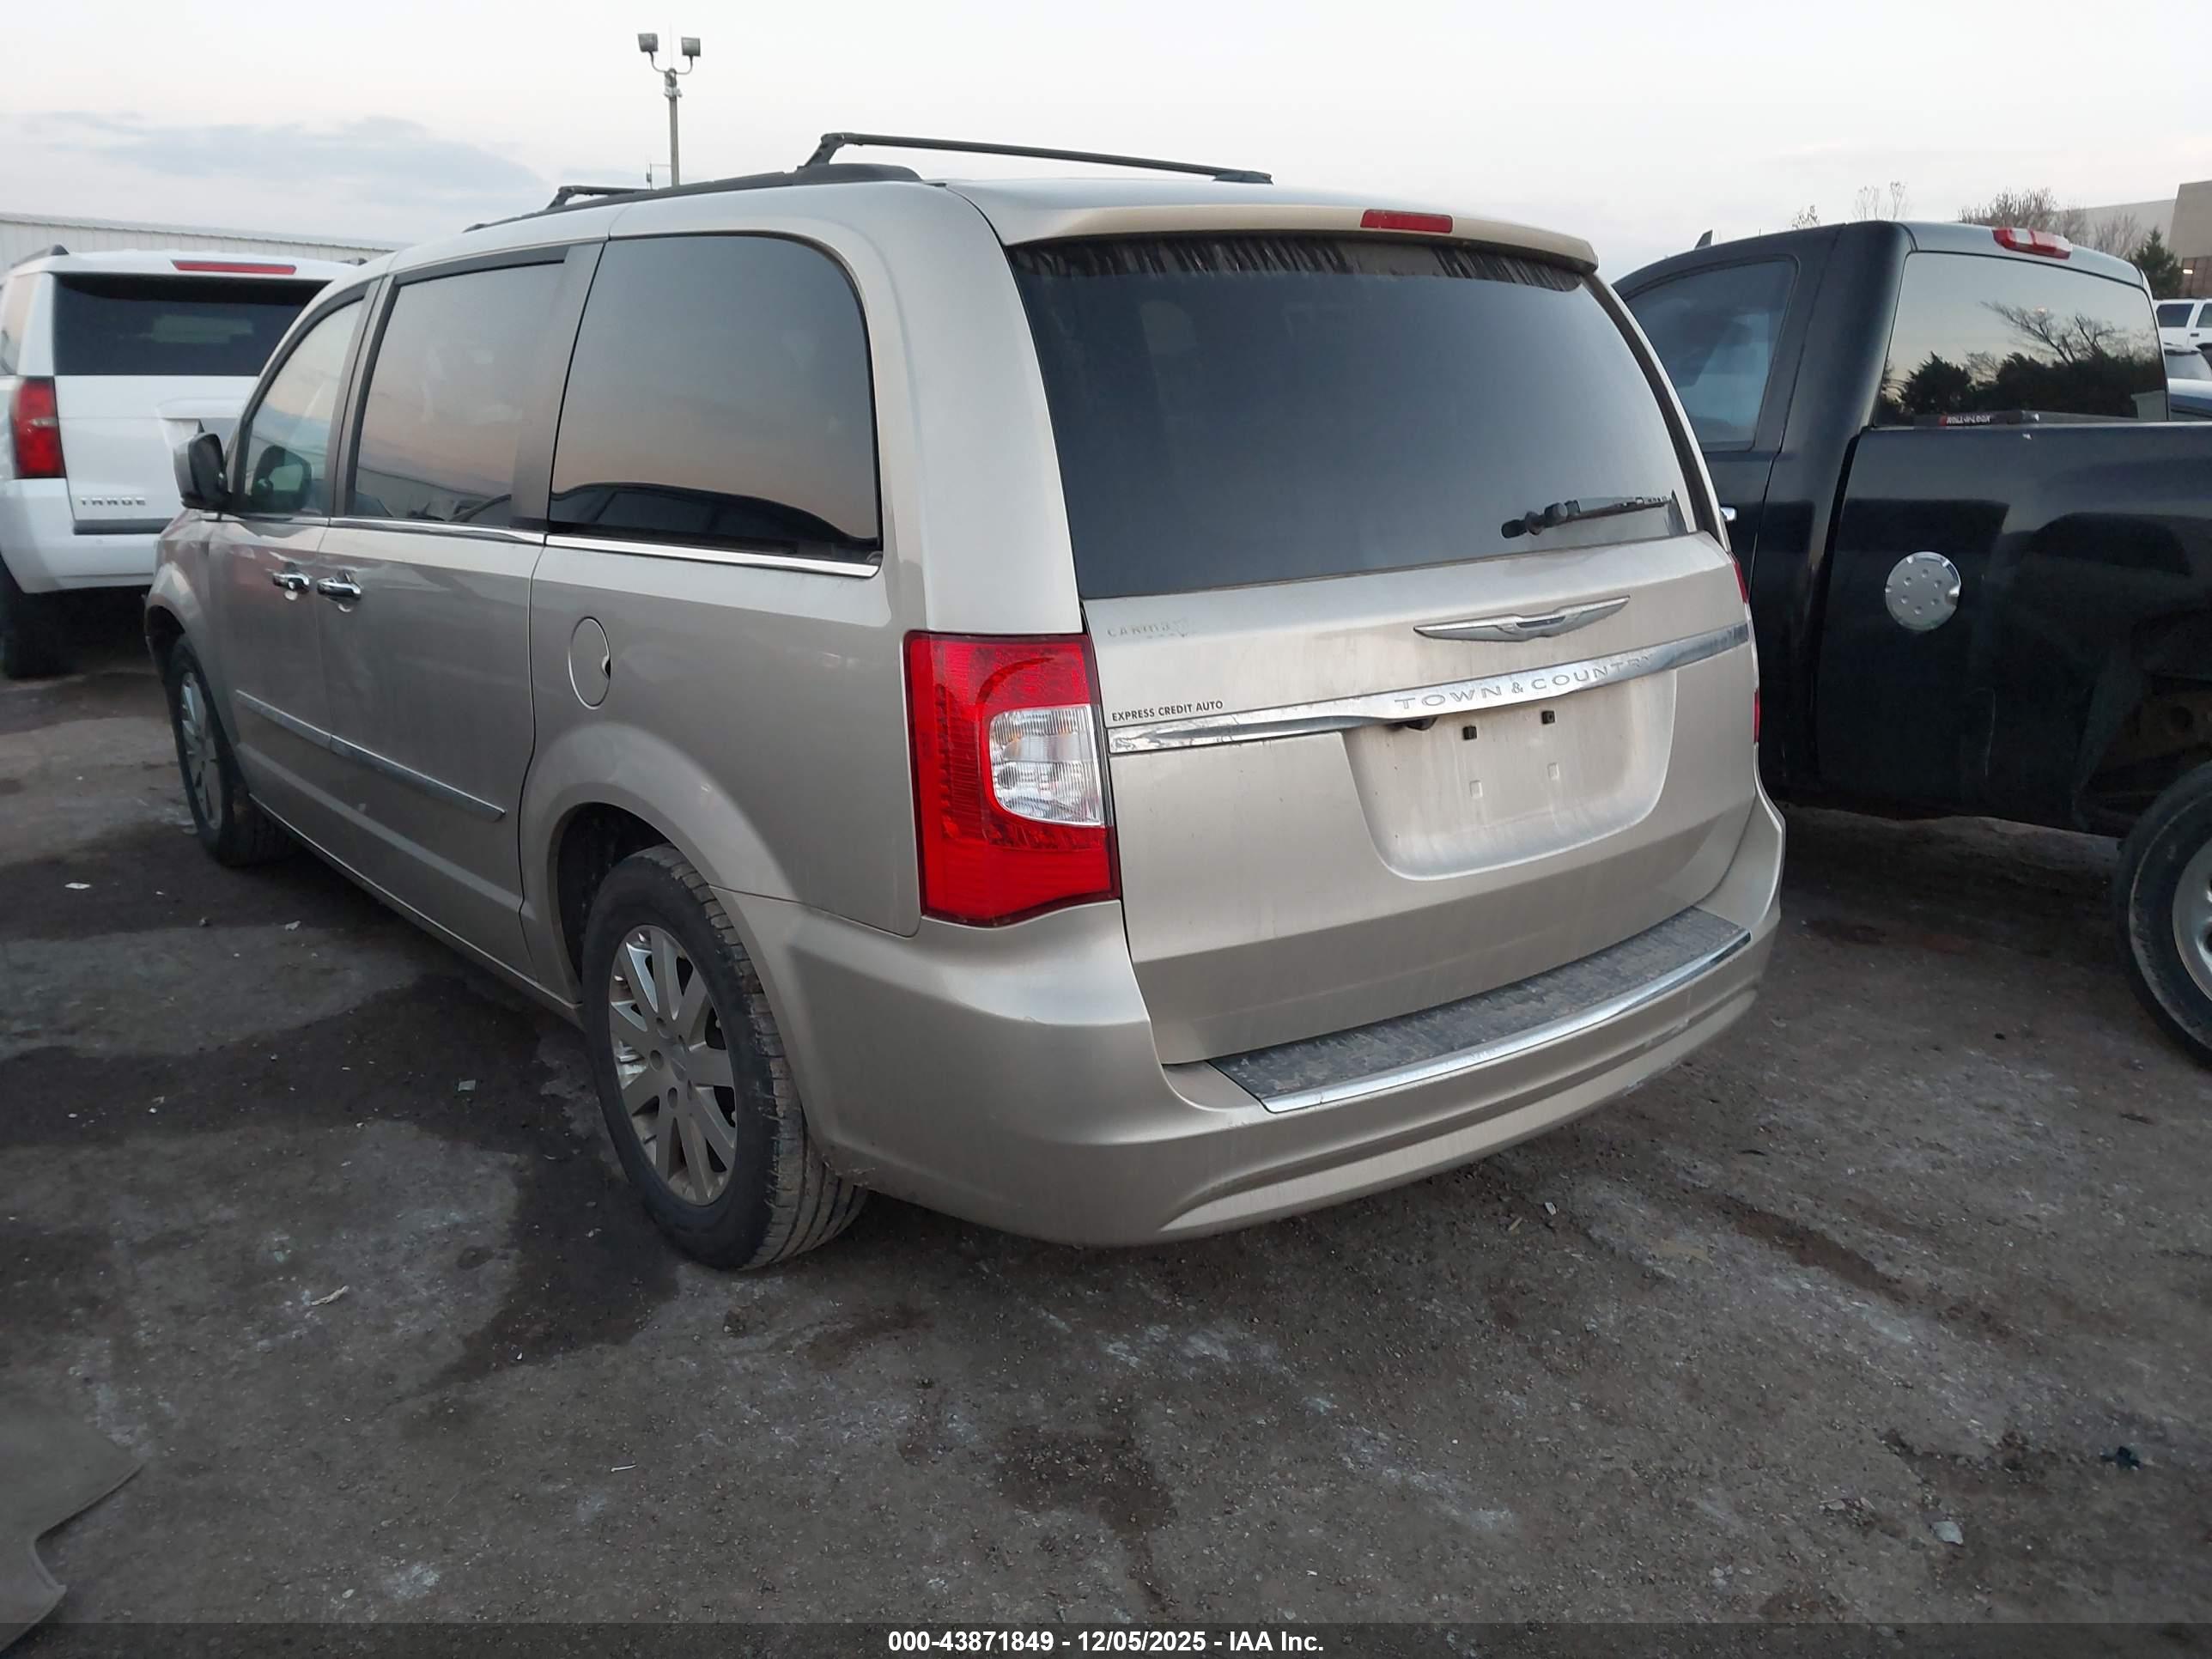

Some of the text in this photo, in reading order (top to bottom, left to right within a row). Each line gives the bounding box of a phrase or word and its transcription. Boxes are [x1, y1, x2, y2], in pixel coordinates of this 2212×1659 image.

[1394, 686, 1503, 710] TOWN
[1111, 700, 1224, 722] EXPRESS CREDIT AUTO
